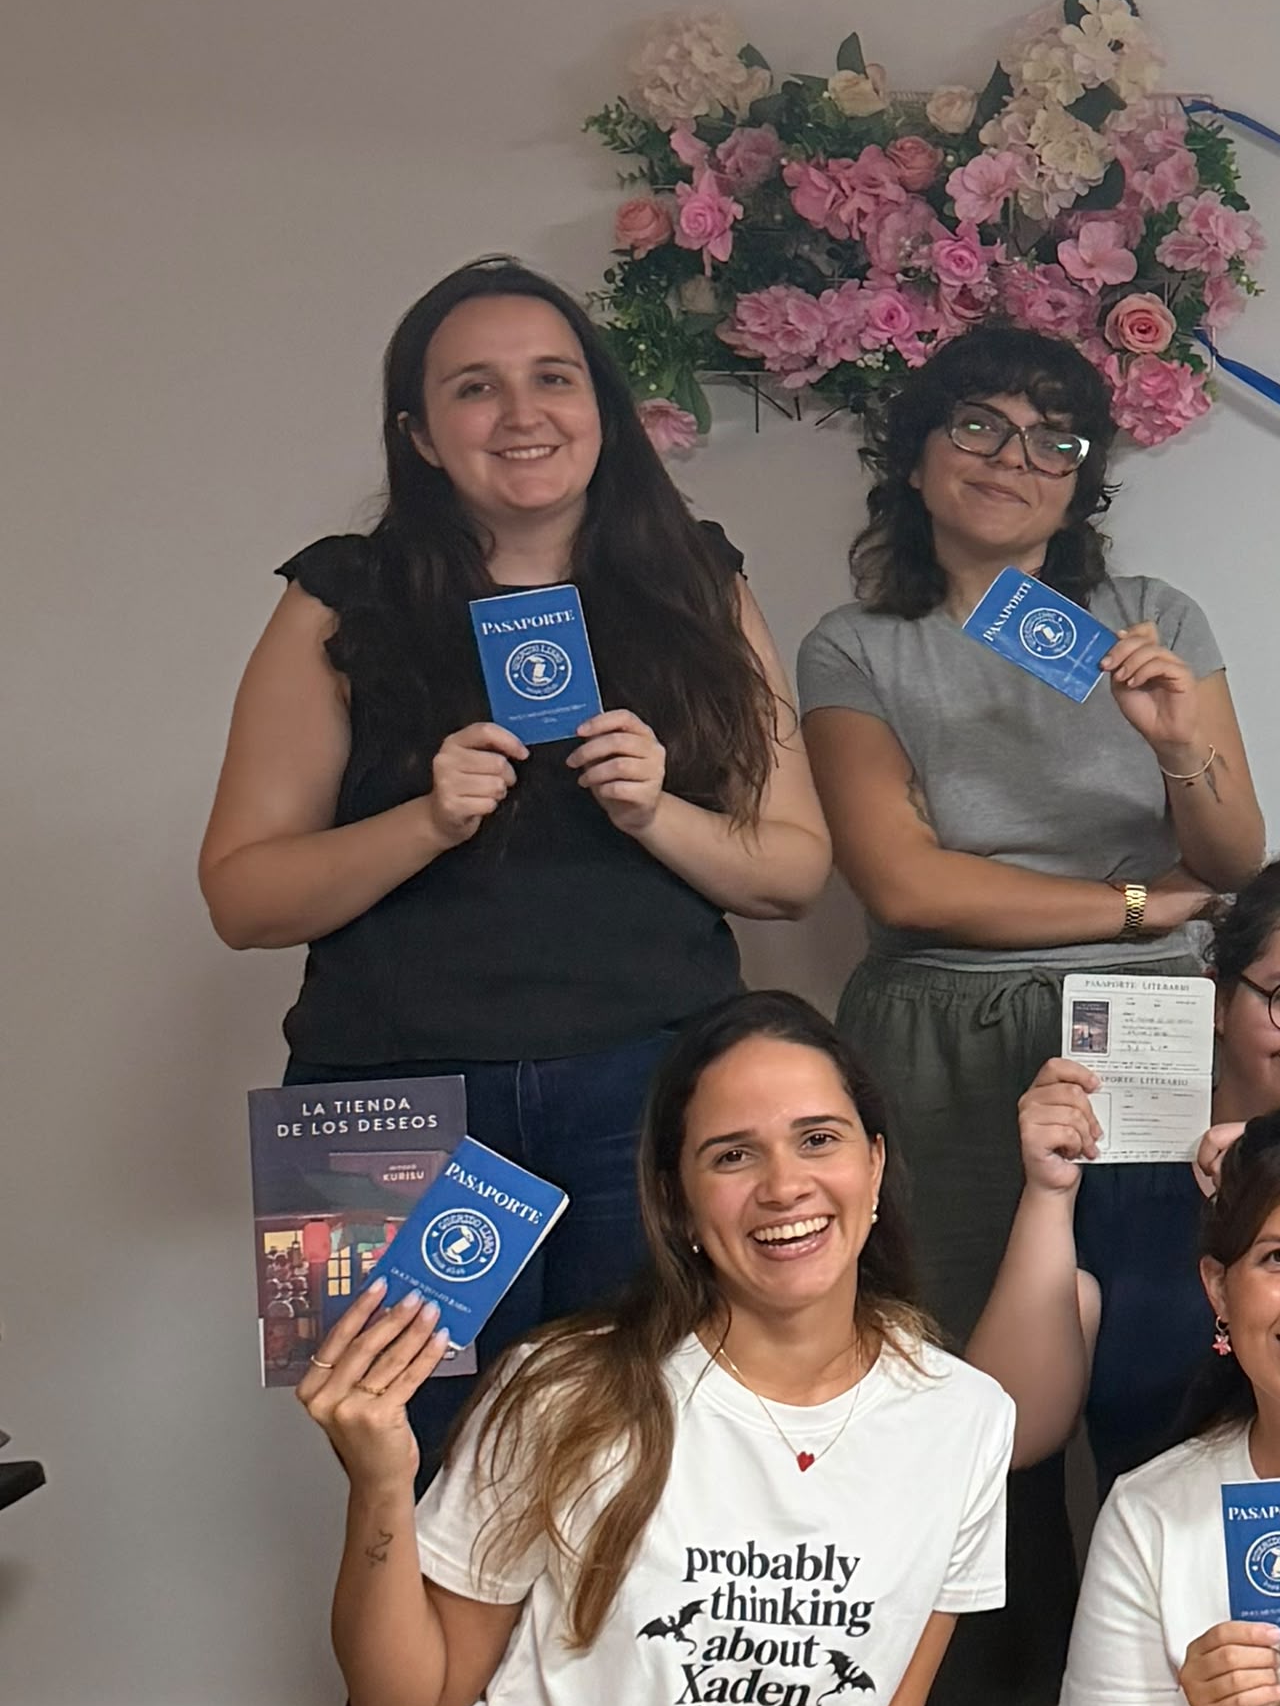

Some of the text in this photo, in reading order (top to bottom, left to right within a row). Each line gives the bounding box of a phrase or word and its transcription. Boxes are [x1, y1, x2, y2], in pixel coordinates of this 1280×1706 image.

[481, 609, 575, 635] PASAPORTE
[277, 1115, 438, 1137] DE LOS DESEOS
[302, 1097, 411, 1117] LA TIENDA
[444, 1162, 543, 1225] PASAPORTE
[682, 1540, 860, 1594] probably
[710, 1581, 875, 1637] thinking
[702, 1626, 820, 1668] about
